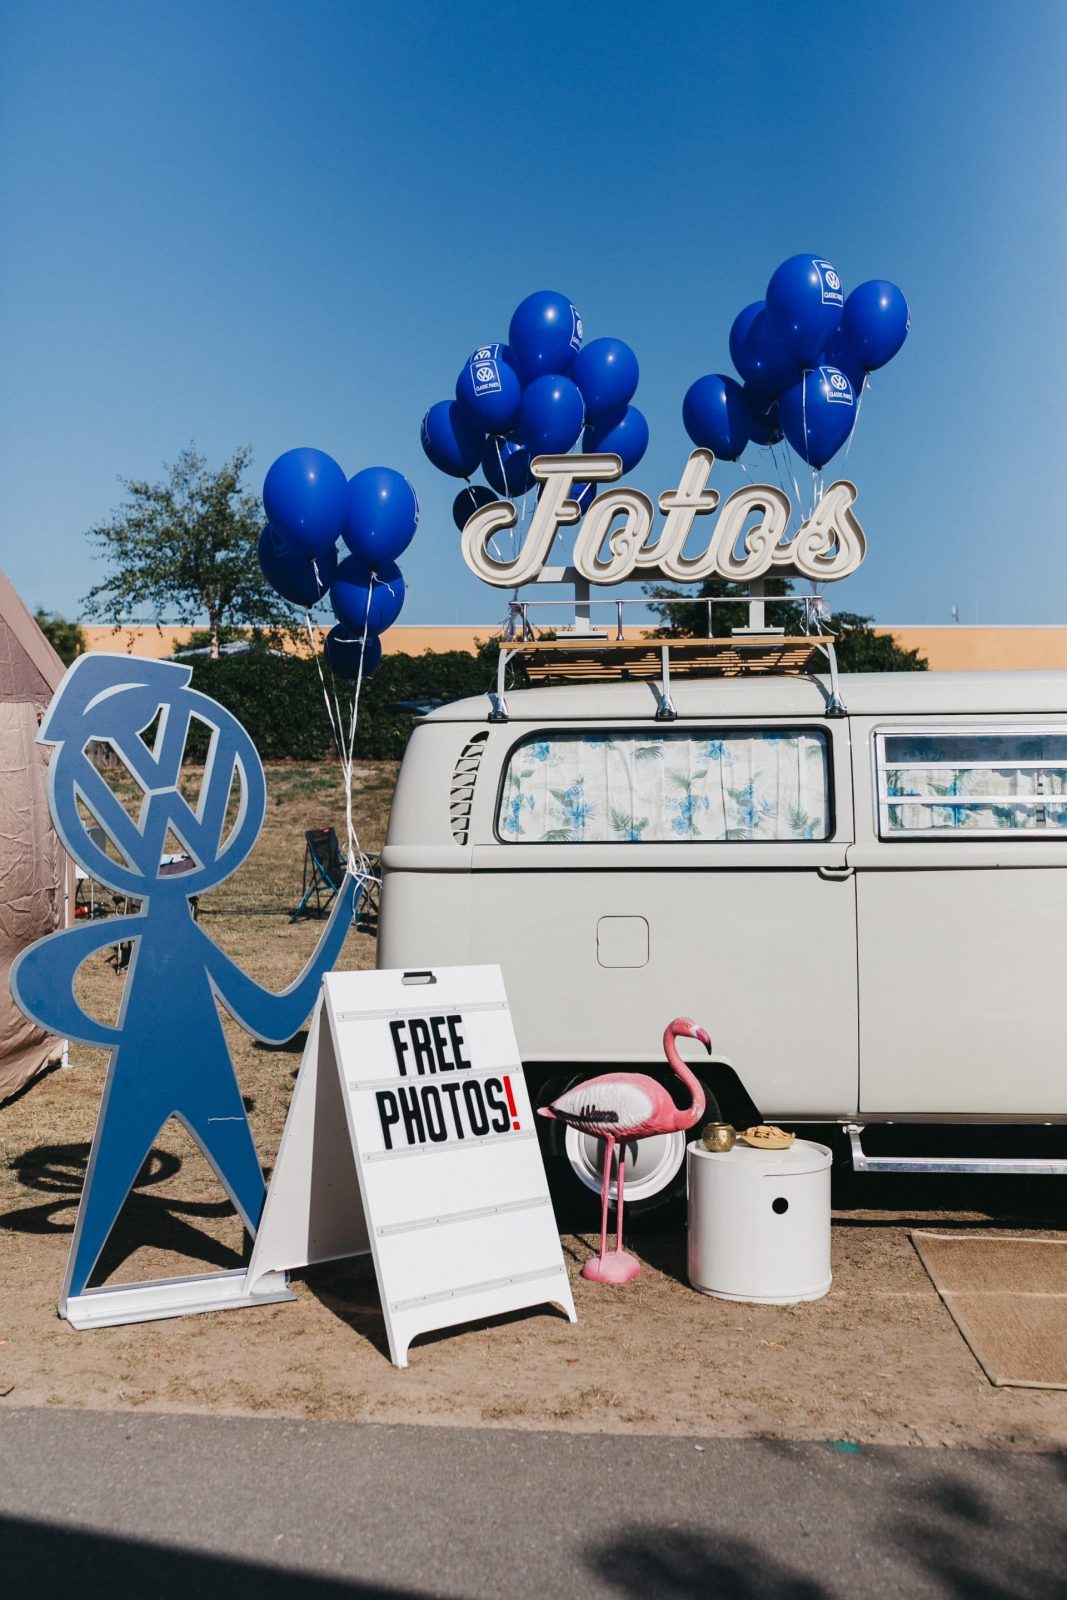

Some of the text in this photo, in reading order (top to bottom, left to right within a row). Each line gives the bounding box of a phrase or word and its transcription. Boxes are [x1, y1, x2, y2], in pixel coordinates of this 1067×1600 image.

[476, 367, 493, 382] VW
[831, 374, 847, 390] VW
[461, 447, 867, 587] Fotos
[389, 1015, 472, 1077] FREE
[375, 1075, 521, 1150] PHOTOS!
